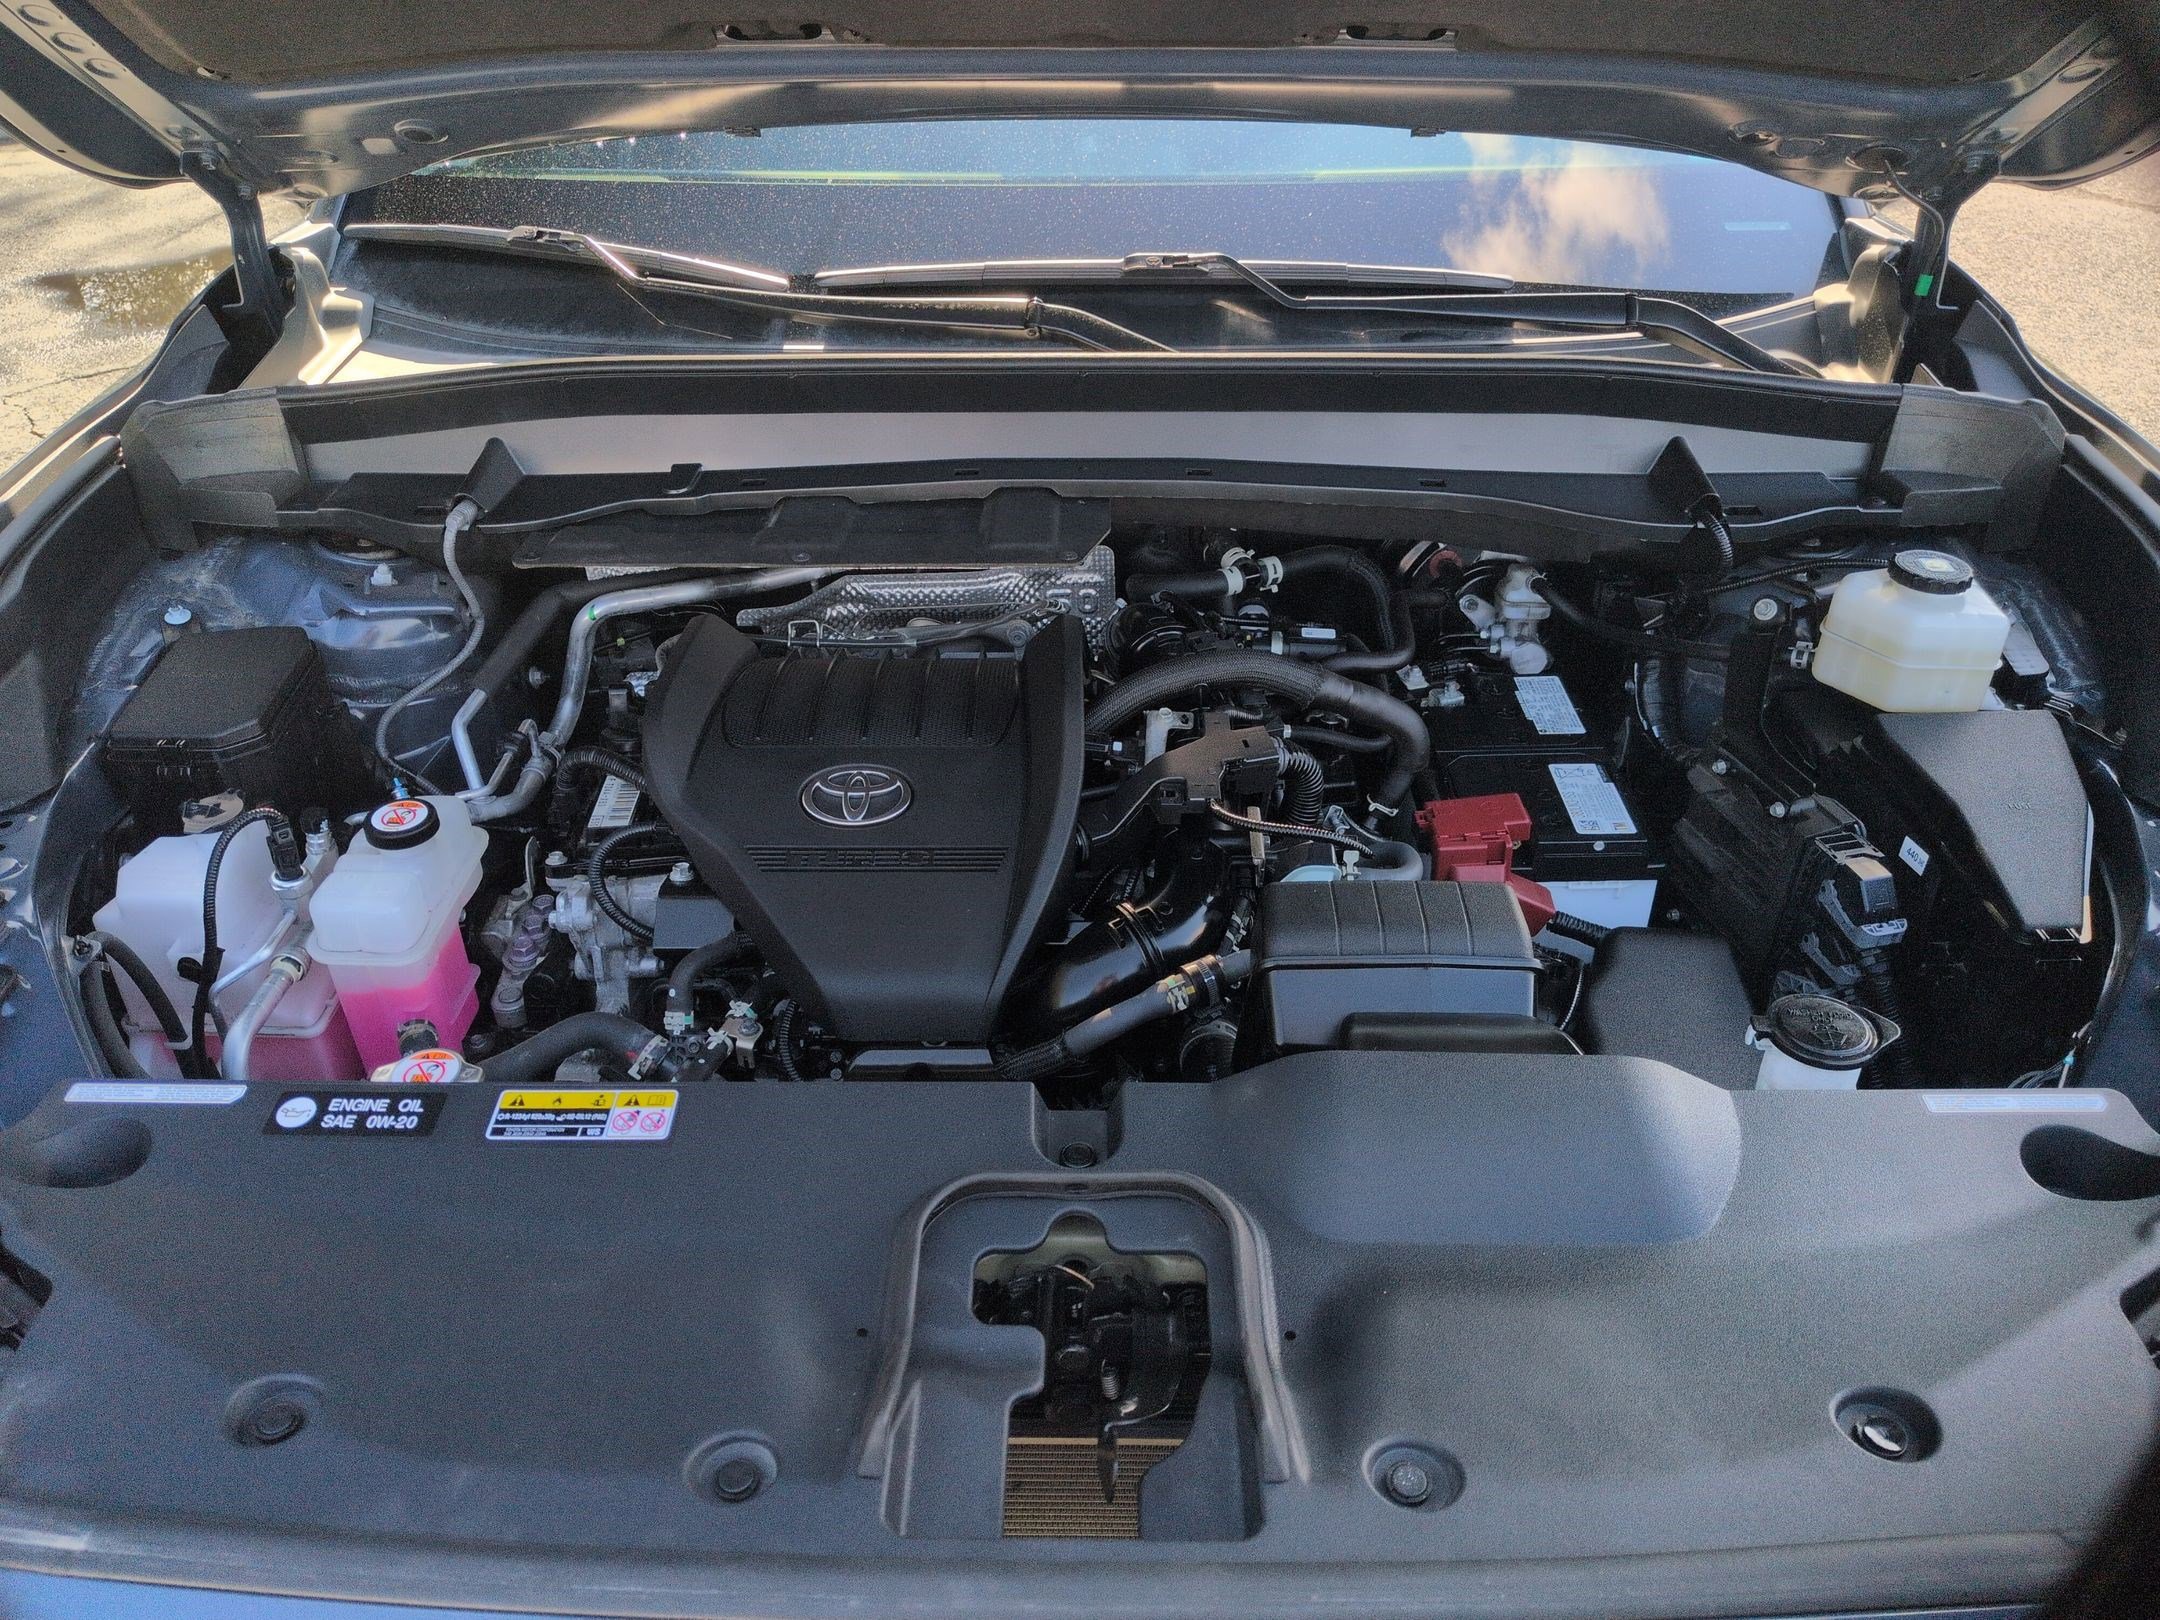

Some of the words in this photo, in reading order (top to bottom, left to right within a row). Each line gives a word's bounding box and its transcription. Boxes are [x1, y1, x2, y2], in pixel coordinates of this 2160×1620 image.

[328, 1098, 390, 1112] ENGINE
[398, 1098, 424, 1113] OIL
[320, 1115, 357, 1129] SAE
[365, 1115, 418, 1129] 0W-20
